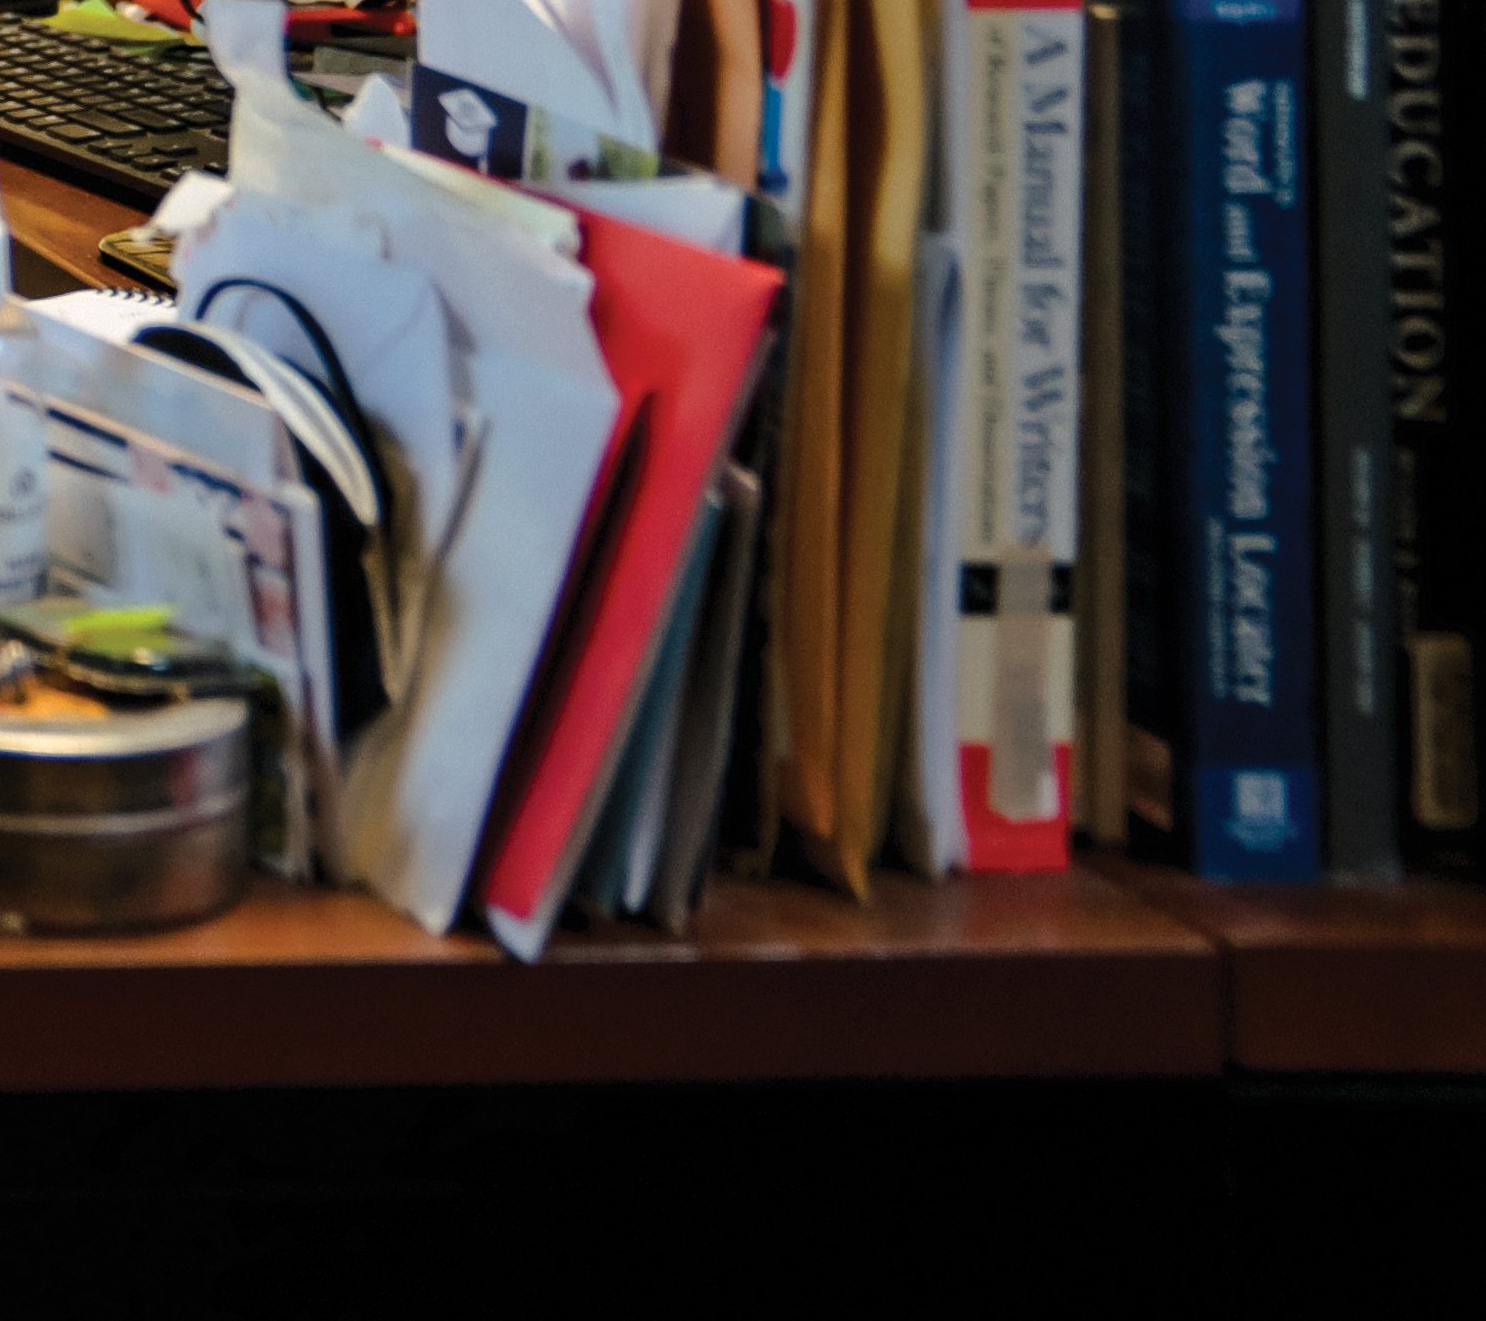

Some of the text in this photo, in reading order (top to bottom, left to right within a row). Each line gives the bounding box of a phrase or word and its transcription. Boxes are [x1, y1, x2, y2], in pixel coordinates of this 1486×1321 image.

[1221, 80, 1275, 196] Word
[1018, 26, 1070, 551] A Manual for Writers
[1213, 269, 1279, 520] Expression
